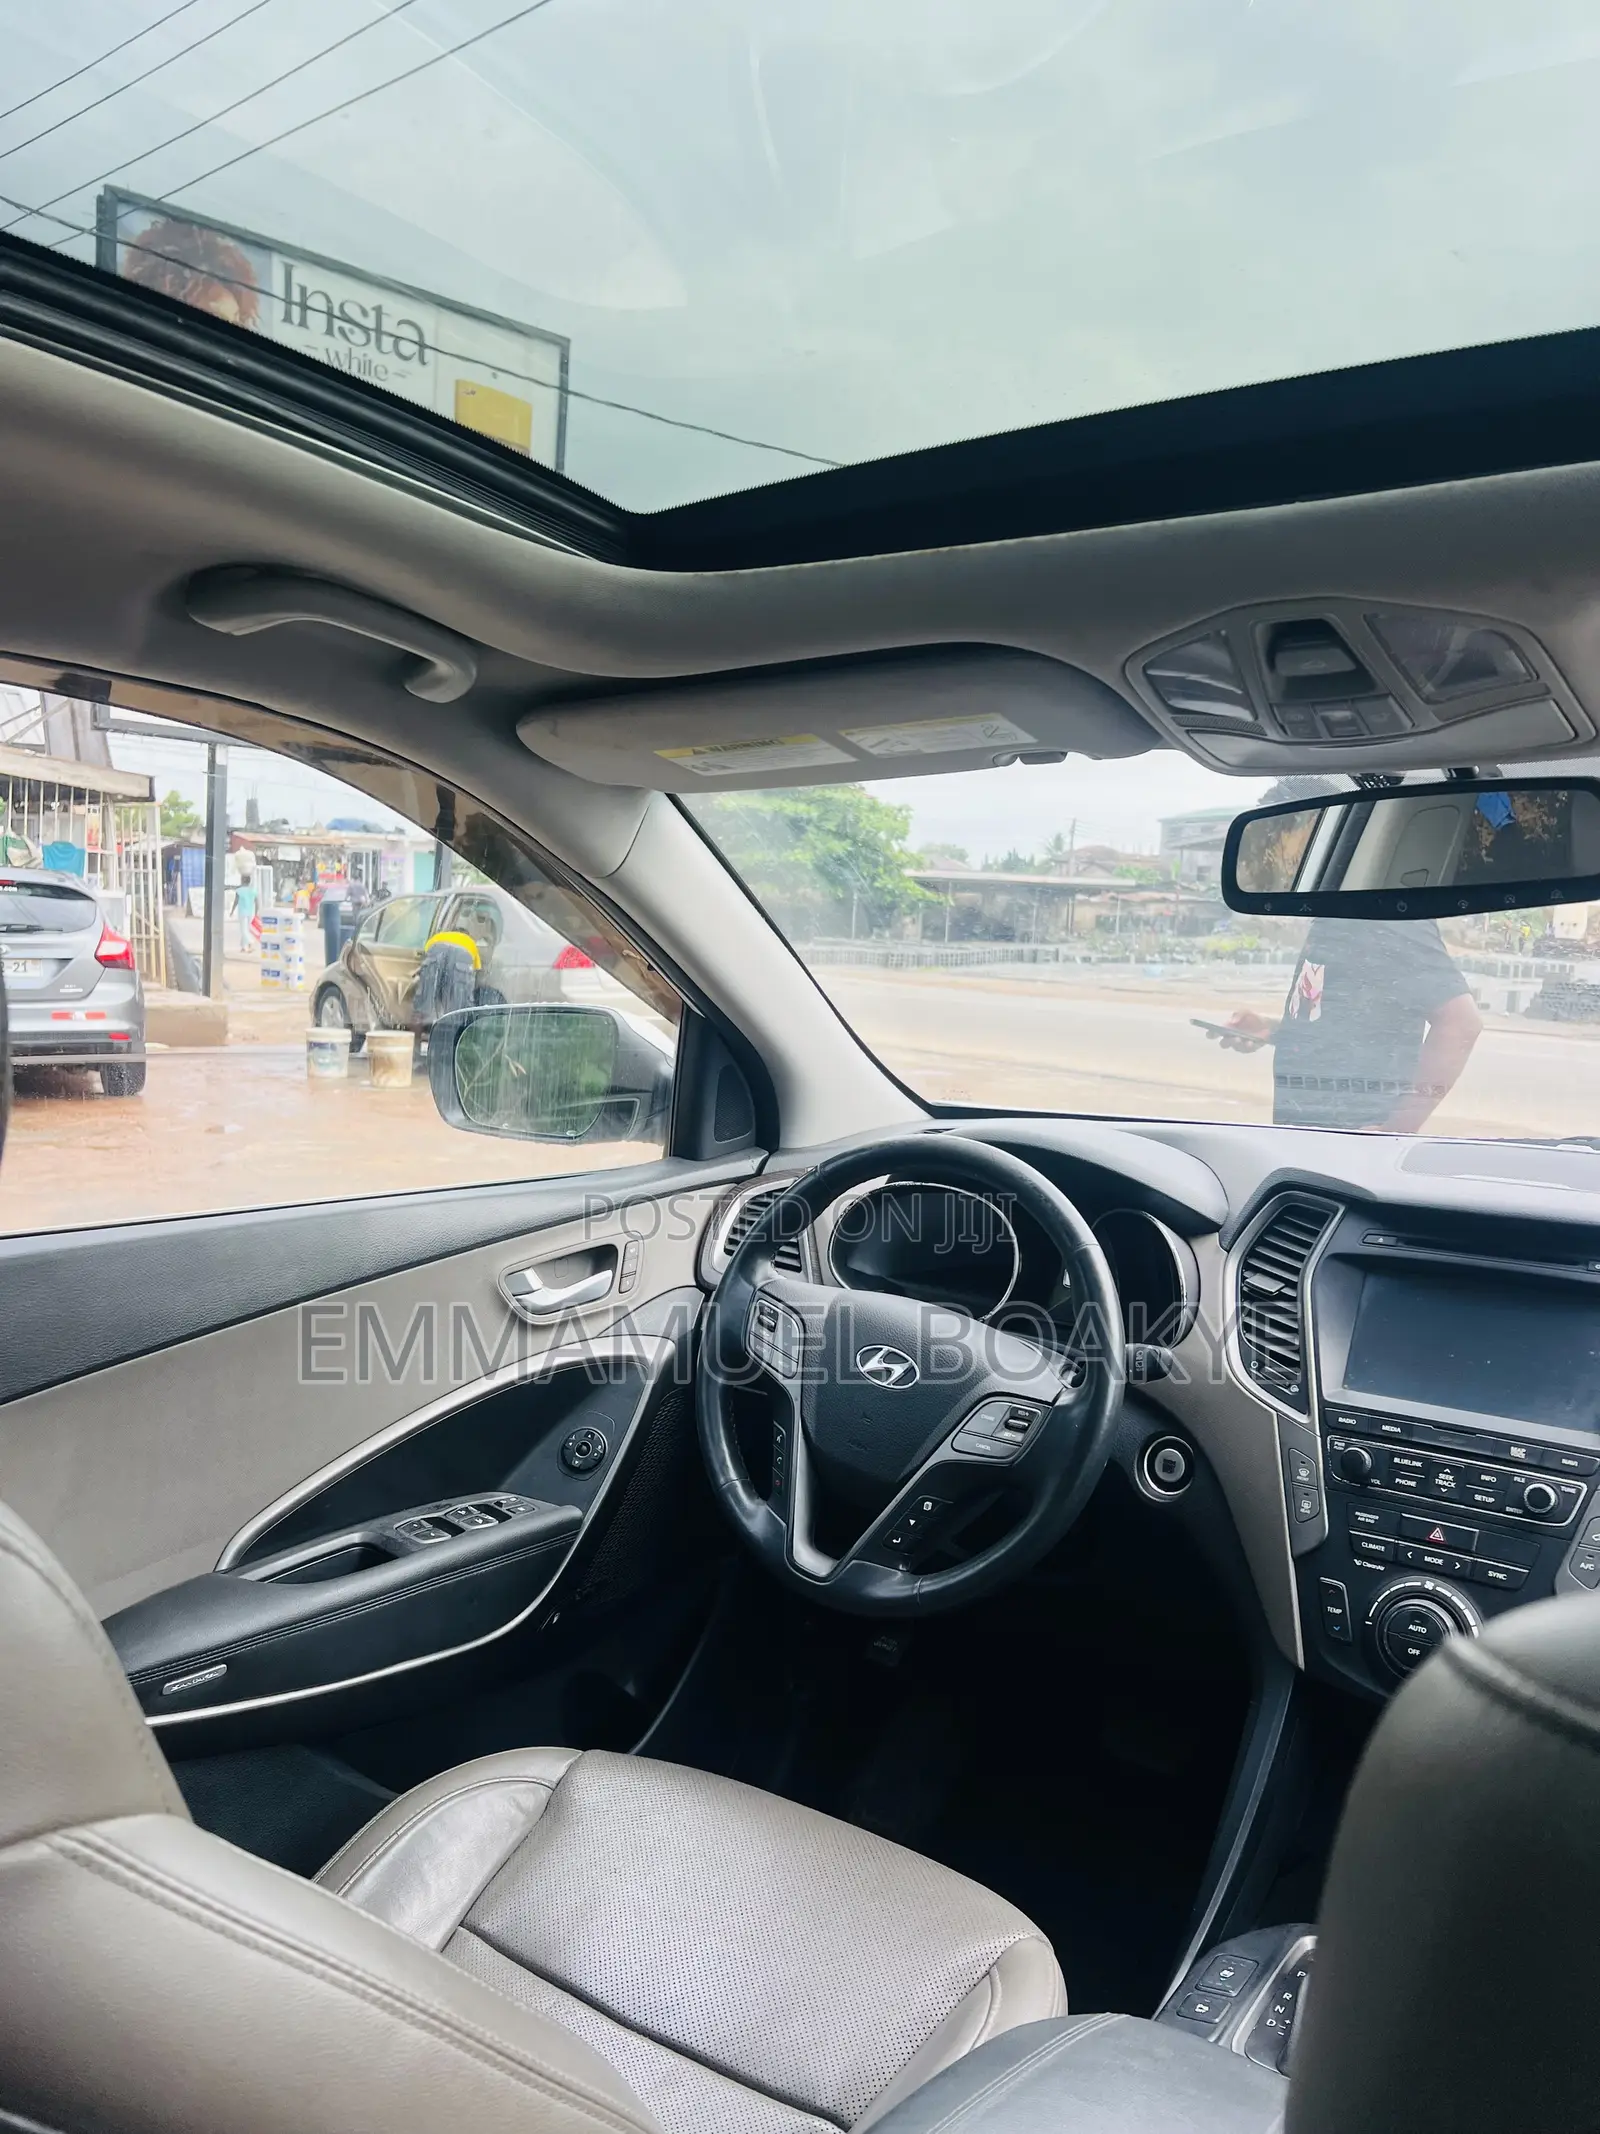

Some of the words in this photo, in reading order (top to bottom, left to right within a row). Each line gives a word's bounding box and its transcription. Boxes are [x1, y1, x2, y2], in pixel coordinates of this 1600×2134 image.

[281, 260, 429, 367] Insta
[1338, 1416, 1357, 1425] RADIO
[1381, 1424, 1401, 1433] MEDIA
[1393, 1457, 1423, 1468] BLUELINK
[1438, 1473, 1454, 1481] SEEK
[1480, 1474, 1497, 1483] INFO
[1395, 1478, 1417, 1488] PHONE
[1435, 1478, 1457, 1488] TRACK
[1474, 1494, 1496, 1504] SETUP
[1361, 1542, 1385, 1552] CLIMATE
[1424, 1555, 1444, 1566] MODE
[1579, 1562, 1595, 1571] A/C
[1487, 1570, 1508, 1581] SYNC
[1327, 1606, 1343, 1615] TEMP
[1408, 1624, 1427, 1634] AUTO
[1407, 1647, 1421, 1656] OFF
[1283, 1992, 1292, 2000] R
[1274, 2005, 1285, 2013] N
[1266, 2018, 1276, 2027] D
